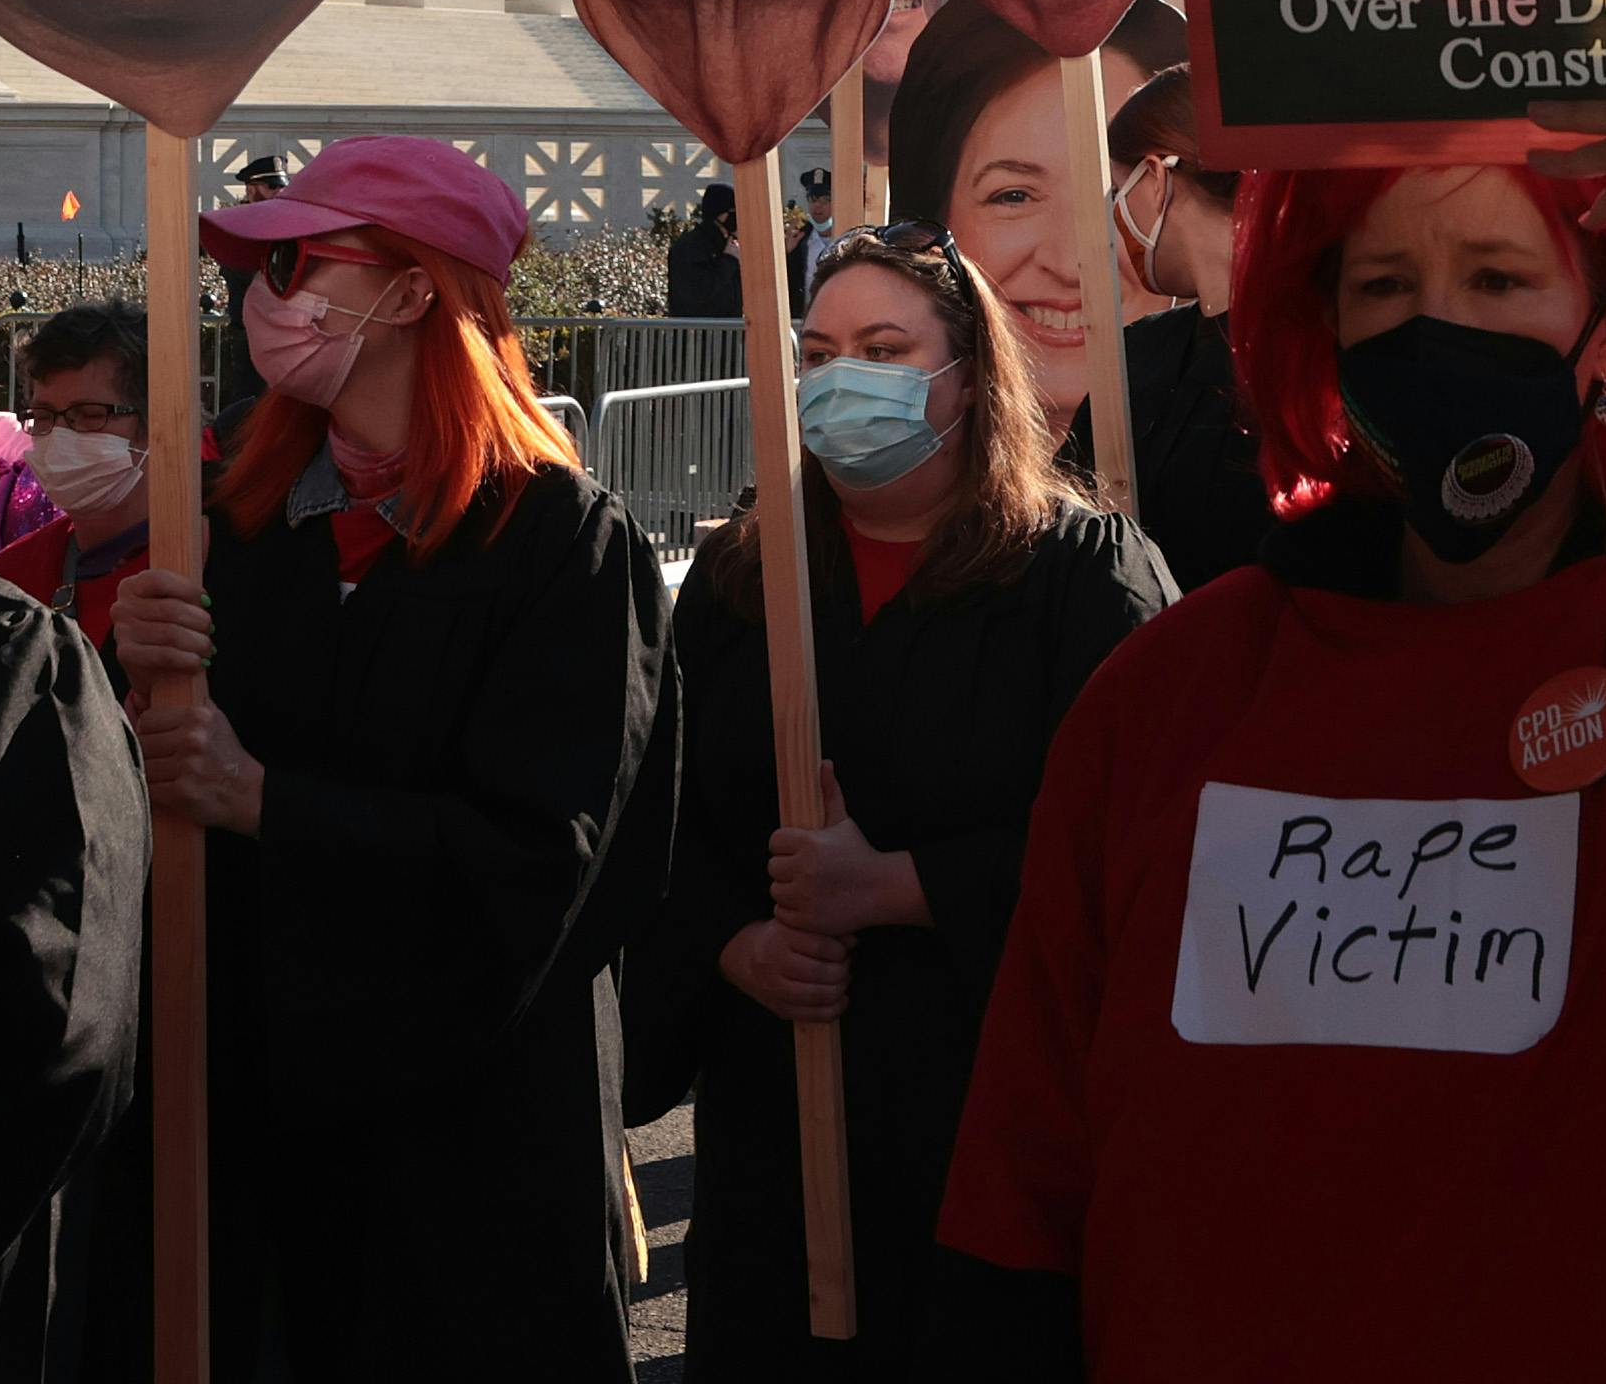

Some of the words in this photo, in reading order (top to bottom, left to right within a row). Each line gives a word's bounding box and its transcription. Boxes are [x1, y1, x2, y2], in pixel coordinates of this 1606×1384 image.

[1517, 703, 1562, 743] CPD
[1522, 712, 1604, 770] ACTION
[1267, 814, 1519, 900] Rape
[1236, 899, 1547, 1003] Victim
